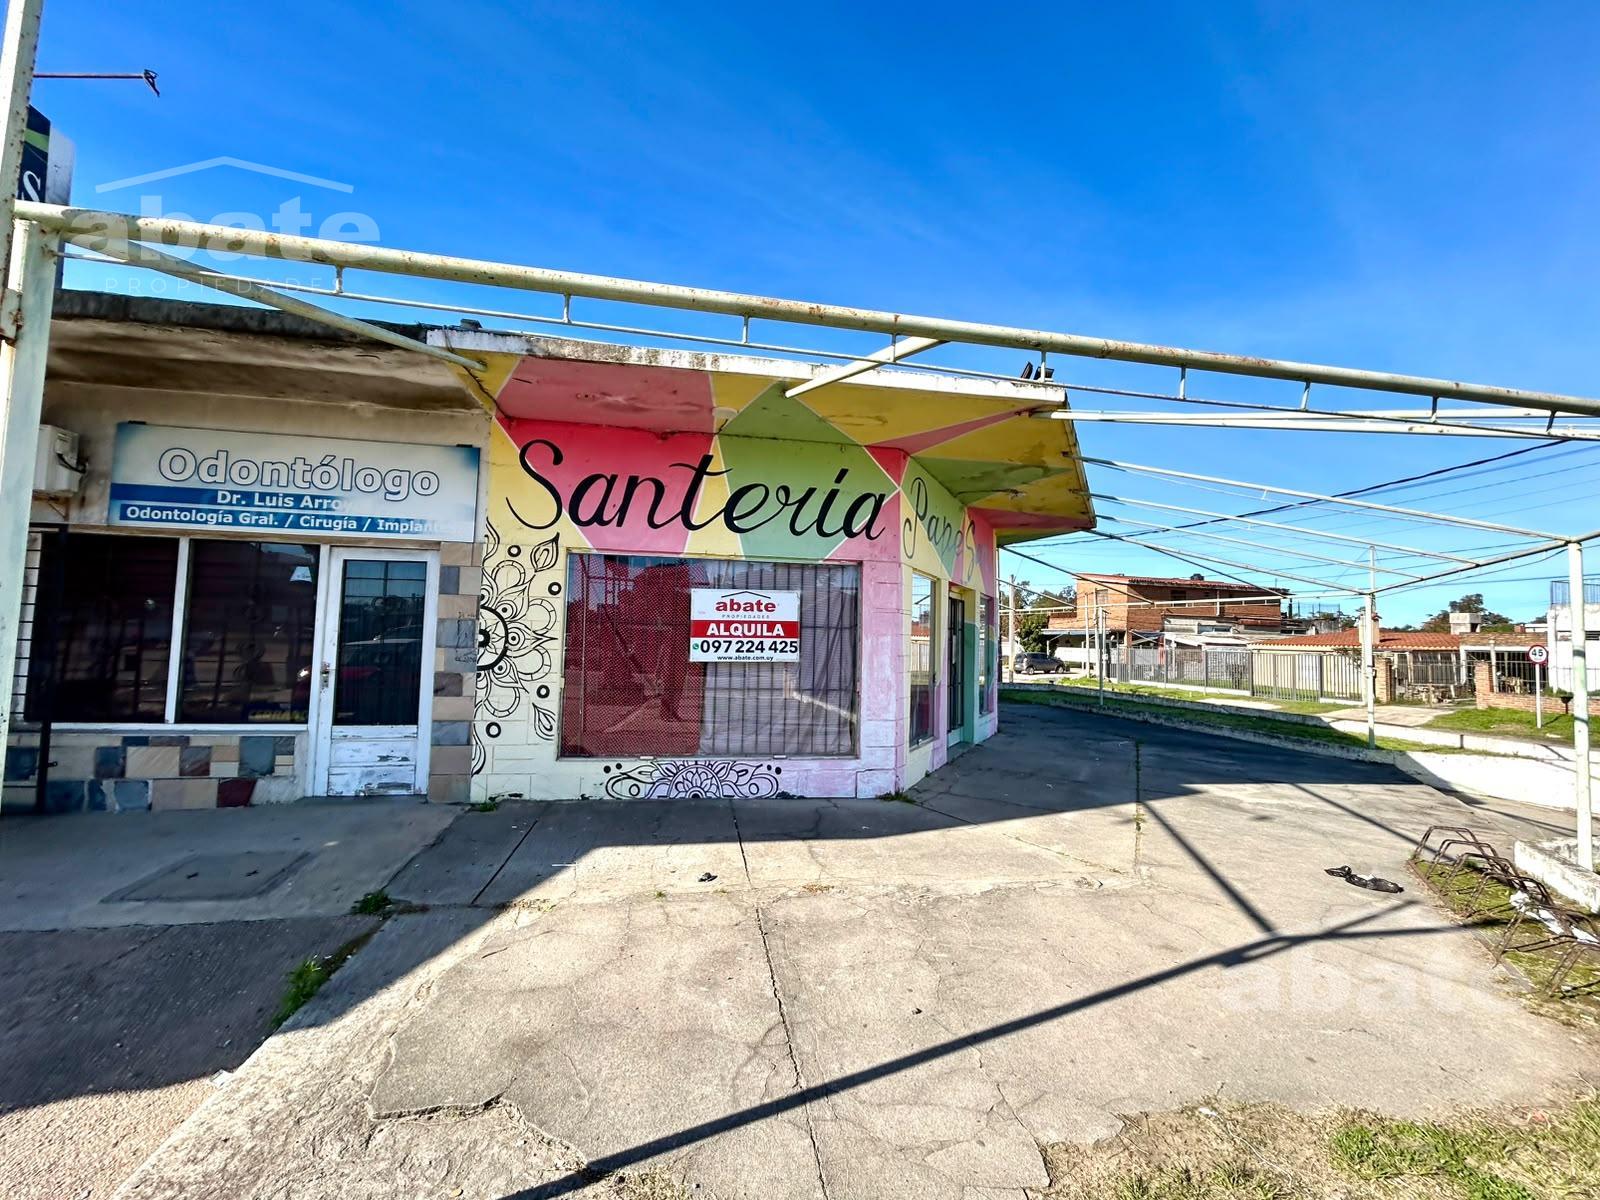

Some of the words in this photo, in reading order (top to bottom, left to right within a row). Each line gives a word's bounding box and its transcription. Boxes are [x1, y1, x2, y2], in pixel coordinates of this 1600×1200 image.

[158, 447, 440, 501] Odontólogo
[217, 489, 246, 505] Dr.
[254, 492, 295, 508] Luis
[126, 506, 233, 525] Odontología
[238, 512, 279, 526] Gral.
[299, 515, 358, 531] Cirugía
[715, 598, 777, 613] abate
[706, 622, 785, 636] ALQUILA
[700, 640, 732, 654] 097
[735, 640, 766, 654] 224
[768, 640, 798, 654] 425
[1531, 648, 1544, 657] 45
